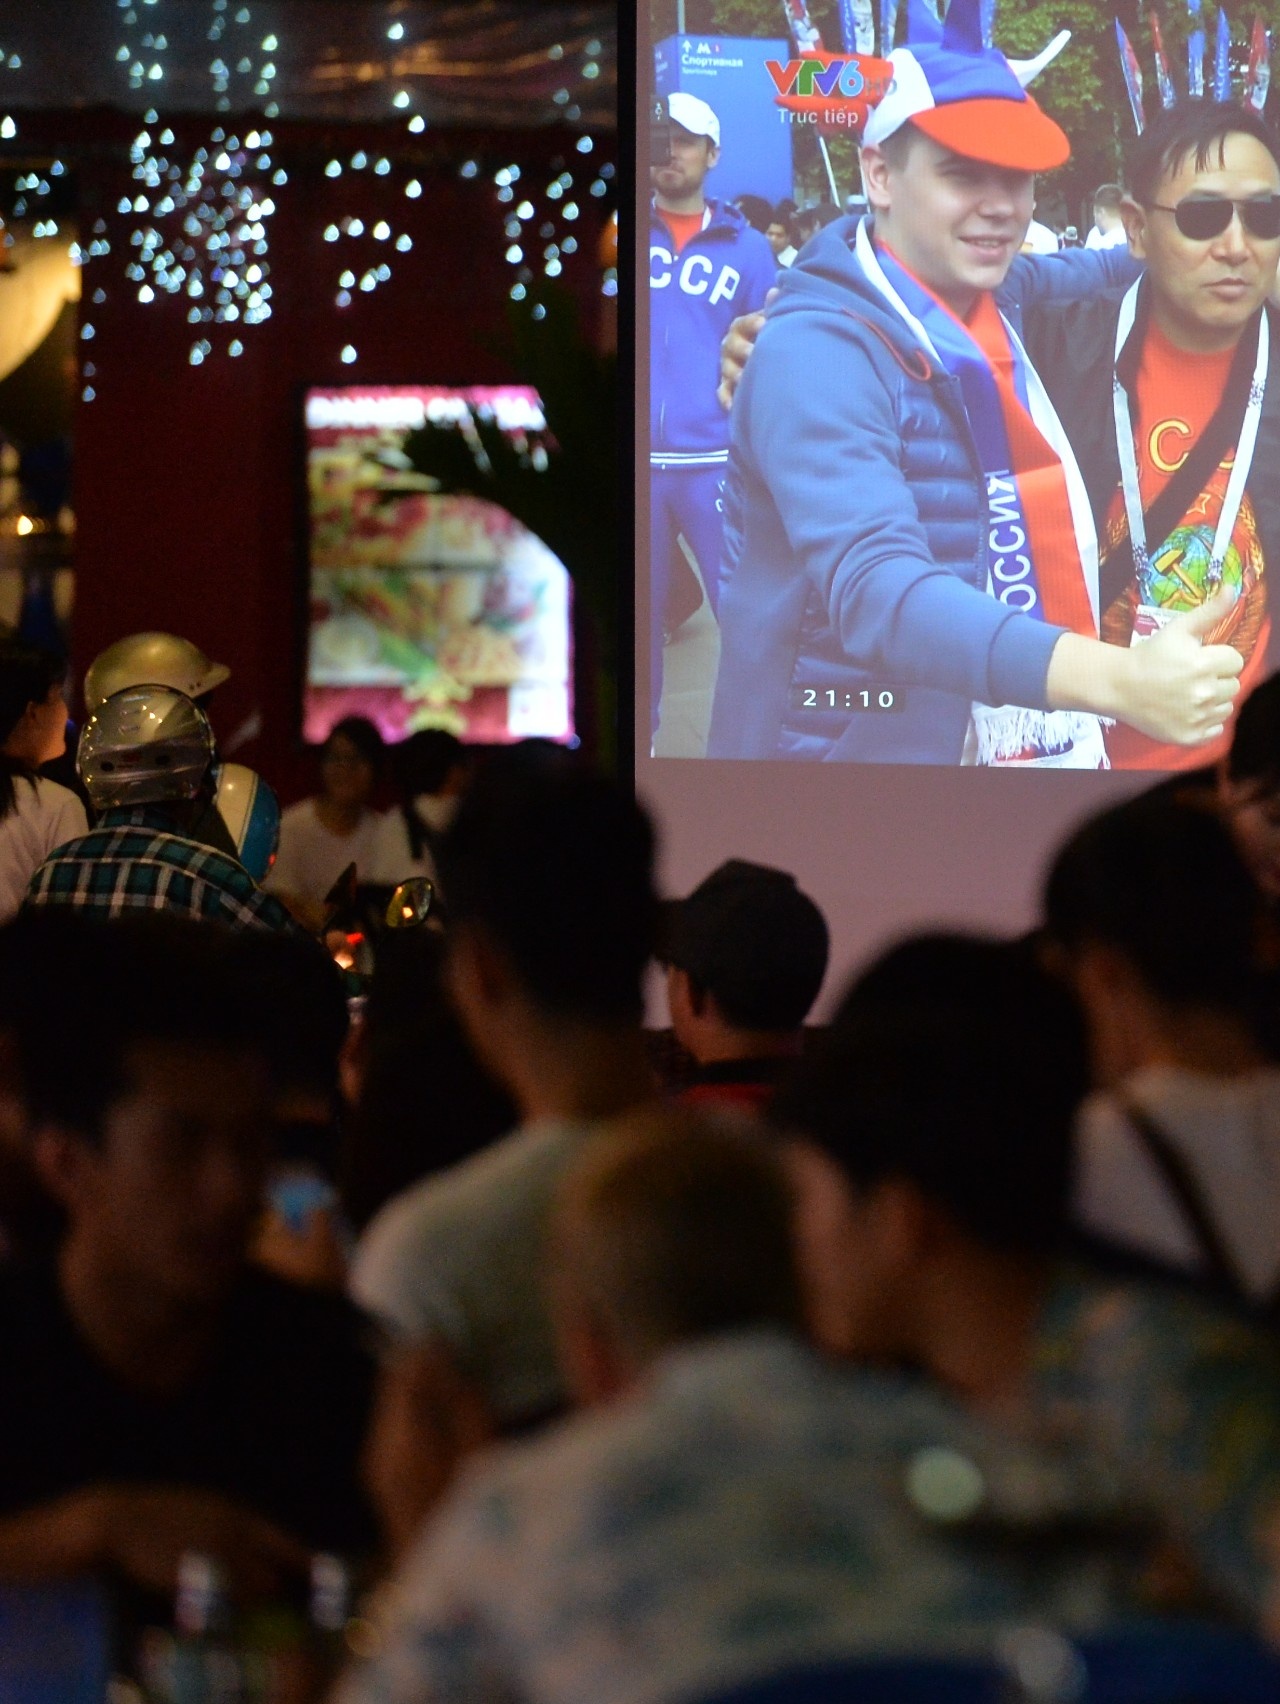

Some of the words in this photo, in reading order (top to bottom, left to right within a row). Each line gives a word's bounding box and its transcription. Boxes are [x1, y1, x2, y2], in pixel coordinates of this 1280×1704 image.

[764, 59, 864, 97] VTV6
[825, 104, 859, 128] tiếp
[803, 689, 894, 708] 21:10
